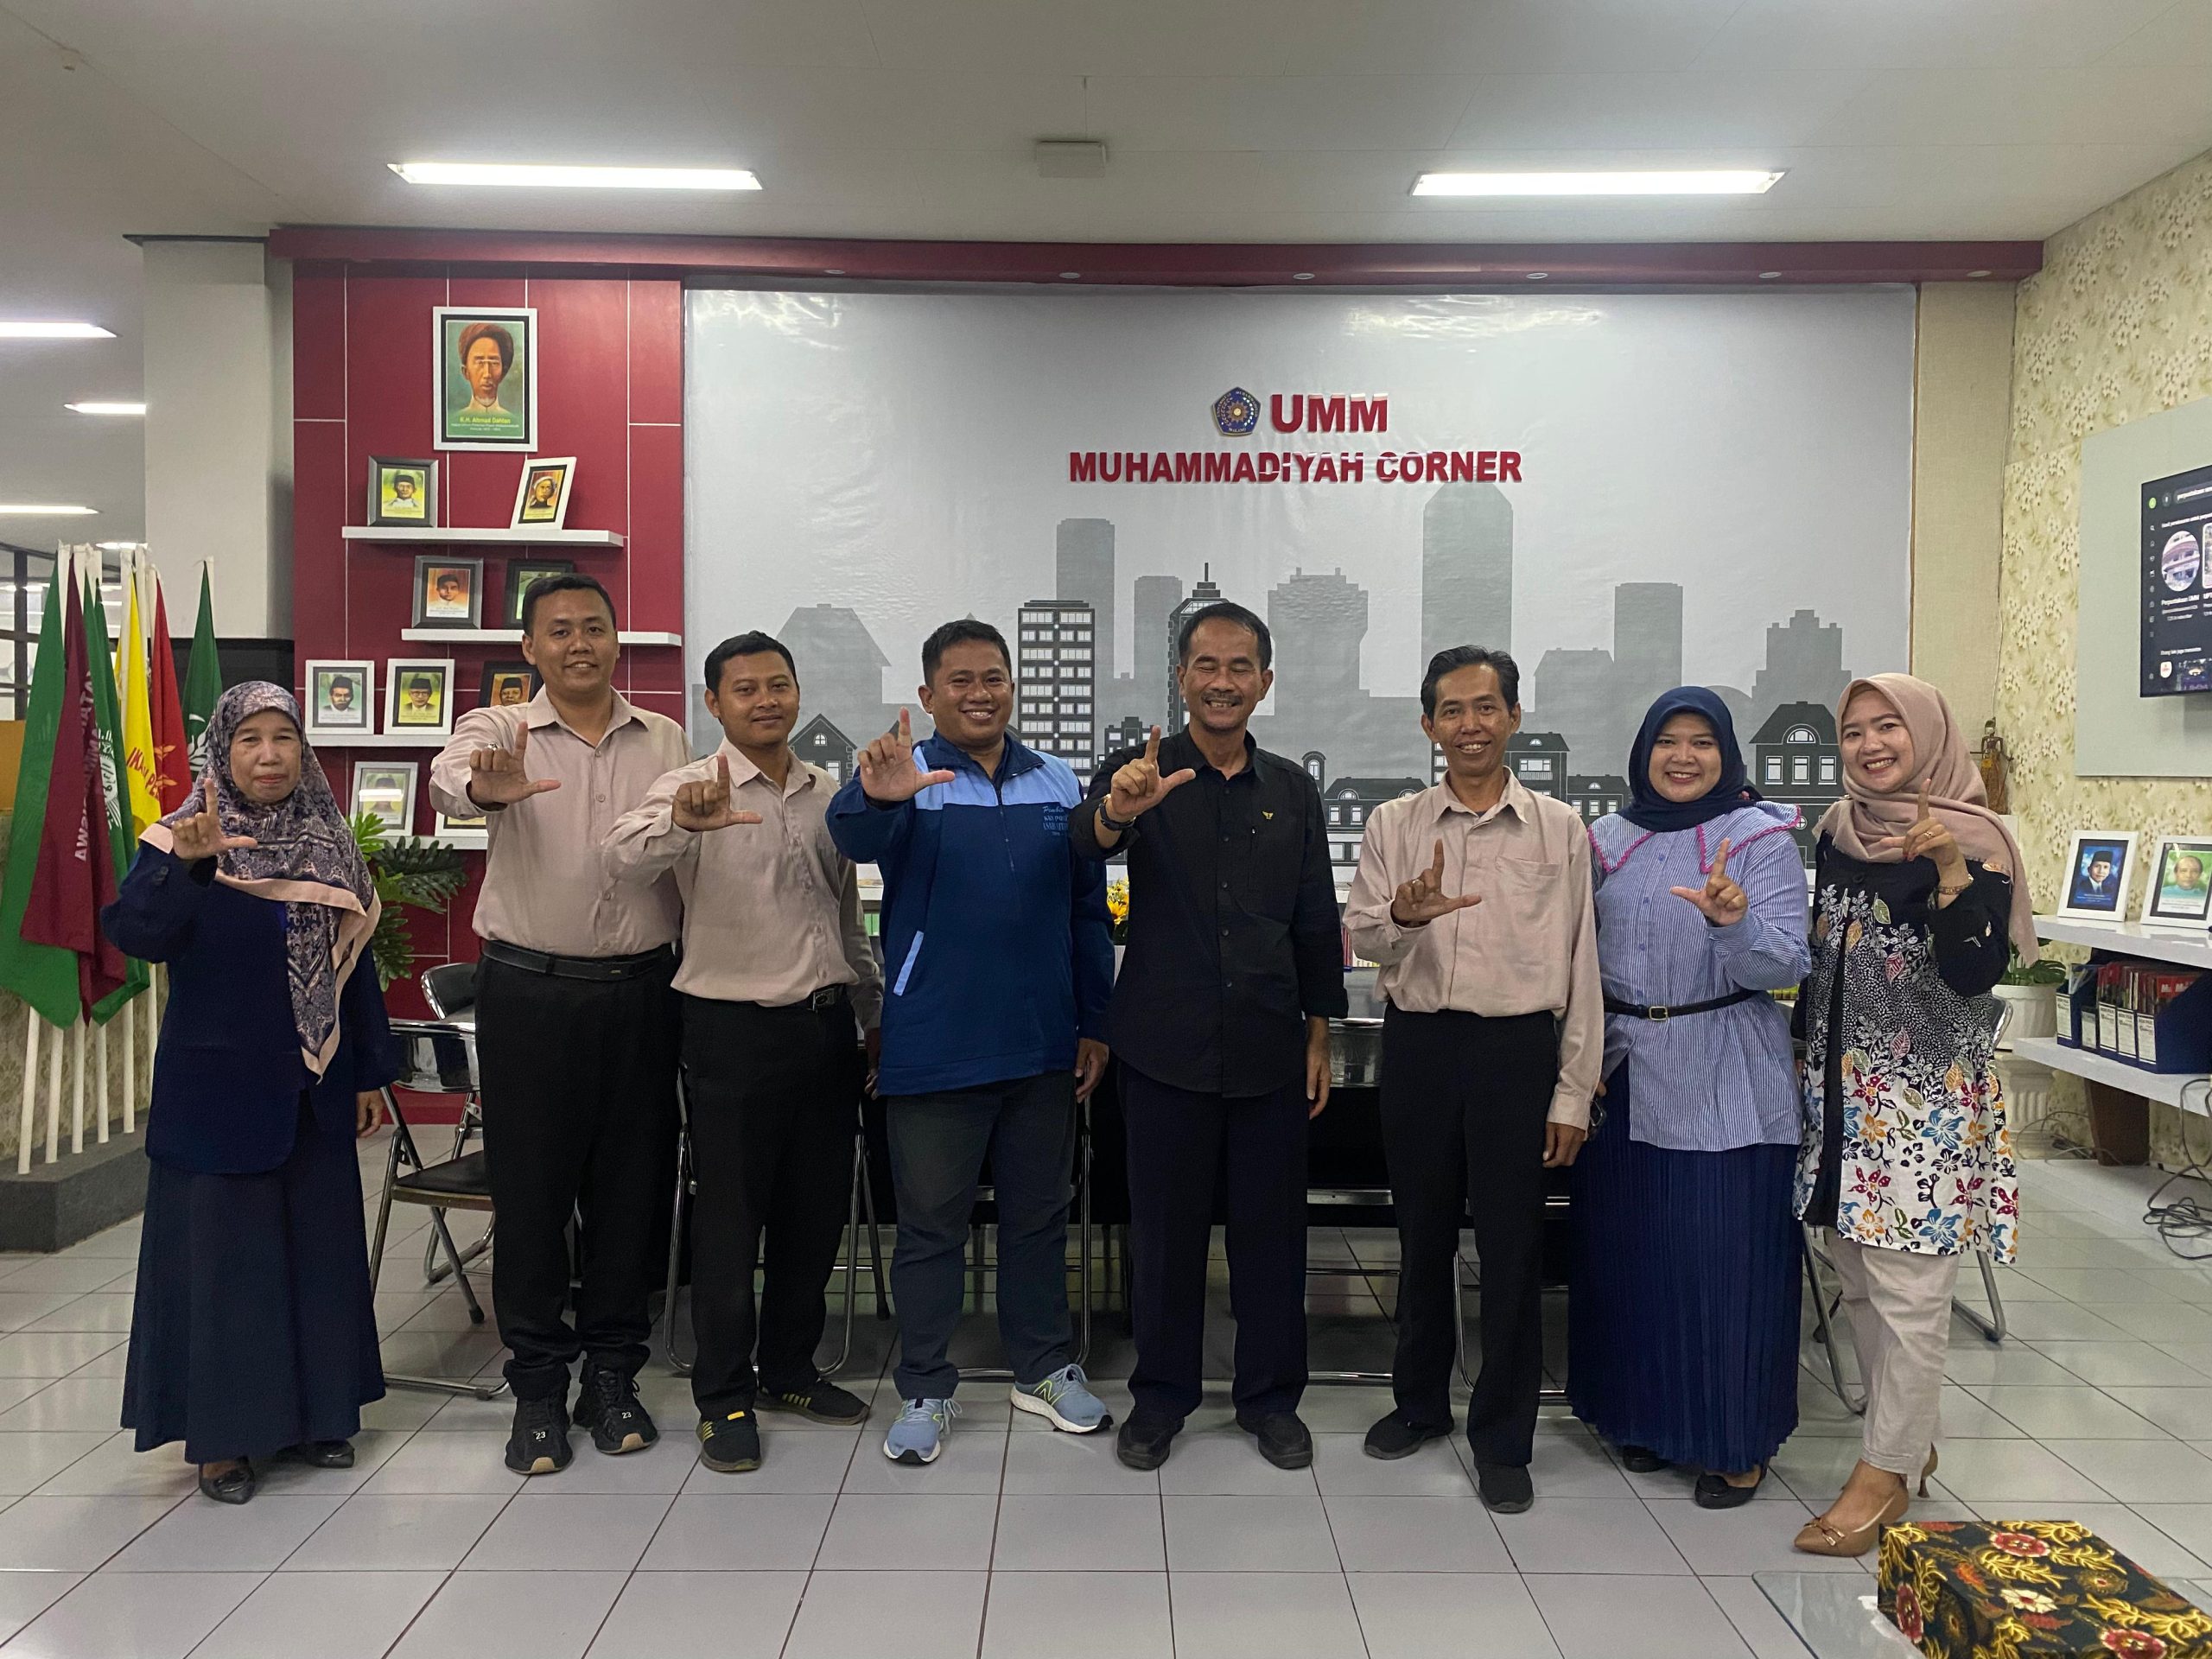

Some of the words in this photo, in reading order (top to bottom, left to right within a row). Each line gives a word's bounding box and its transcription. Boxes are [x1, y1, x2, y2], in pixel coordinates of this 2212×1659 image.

[1270, 393, 1388, 433] UMM
[1070, 451, 1363, 482] MUHAMMADIYAH
[1376, 451, 1522, 483] CORNER
[535, 1430, 546, 1440] 23
